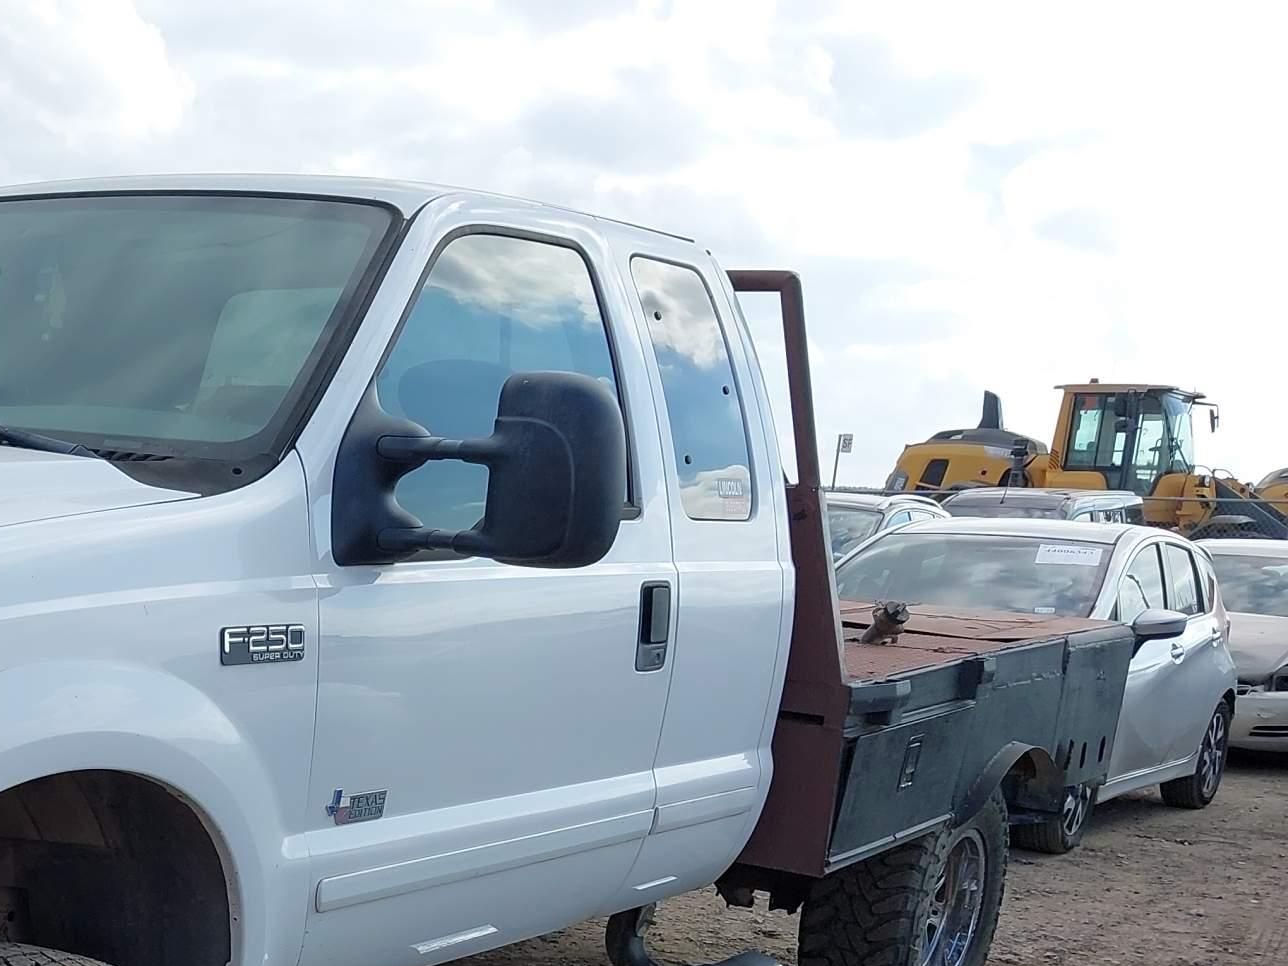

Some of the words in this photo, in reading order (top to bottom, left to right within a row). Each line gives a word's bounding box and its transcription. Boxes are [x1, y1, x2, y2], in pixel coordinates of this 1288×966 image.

[252, 652, 281, 661] SUPER
[282, 650, 305, 659] DUTY
[349, 792, 386, 809] TEXAS
[348, 804, 384, 820] EDITION
